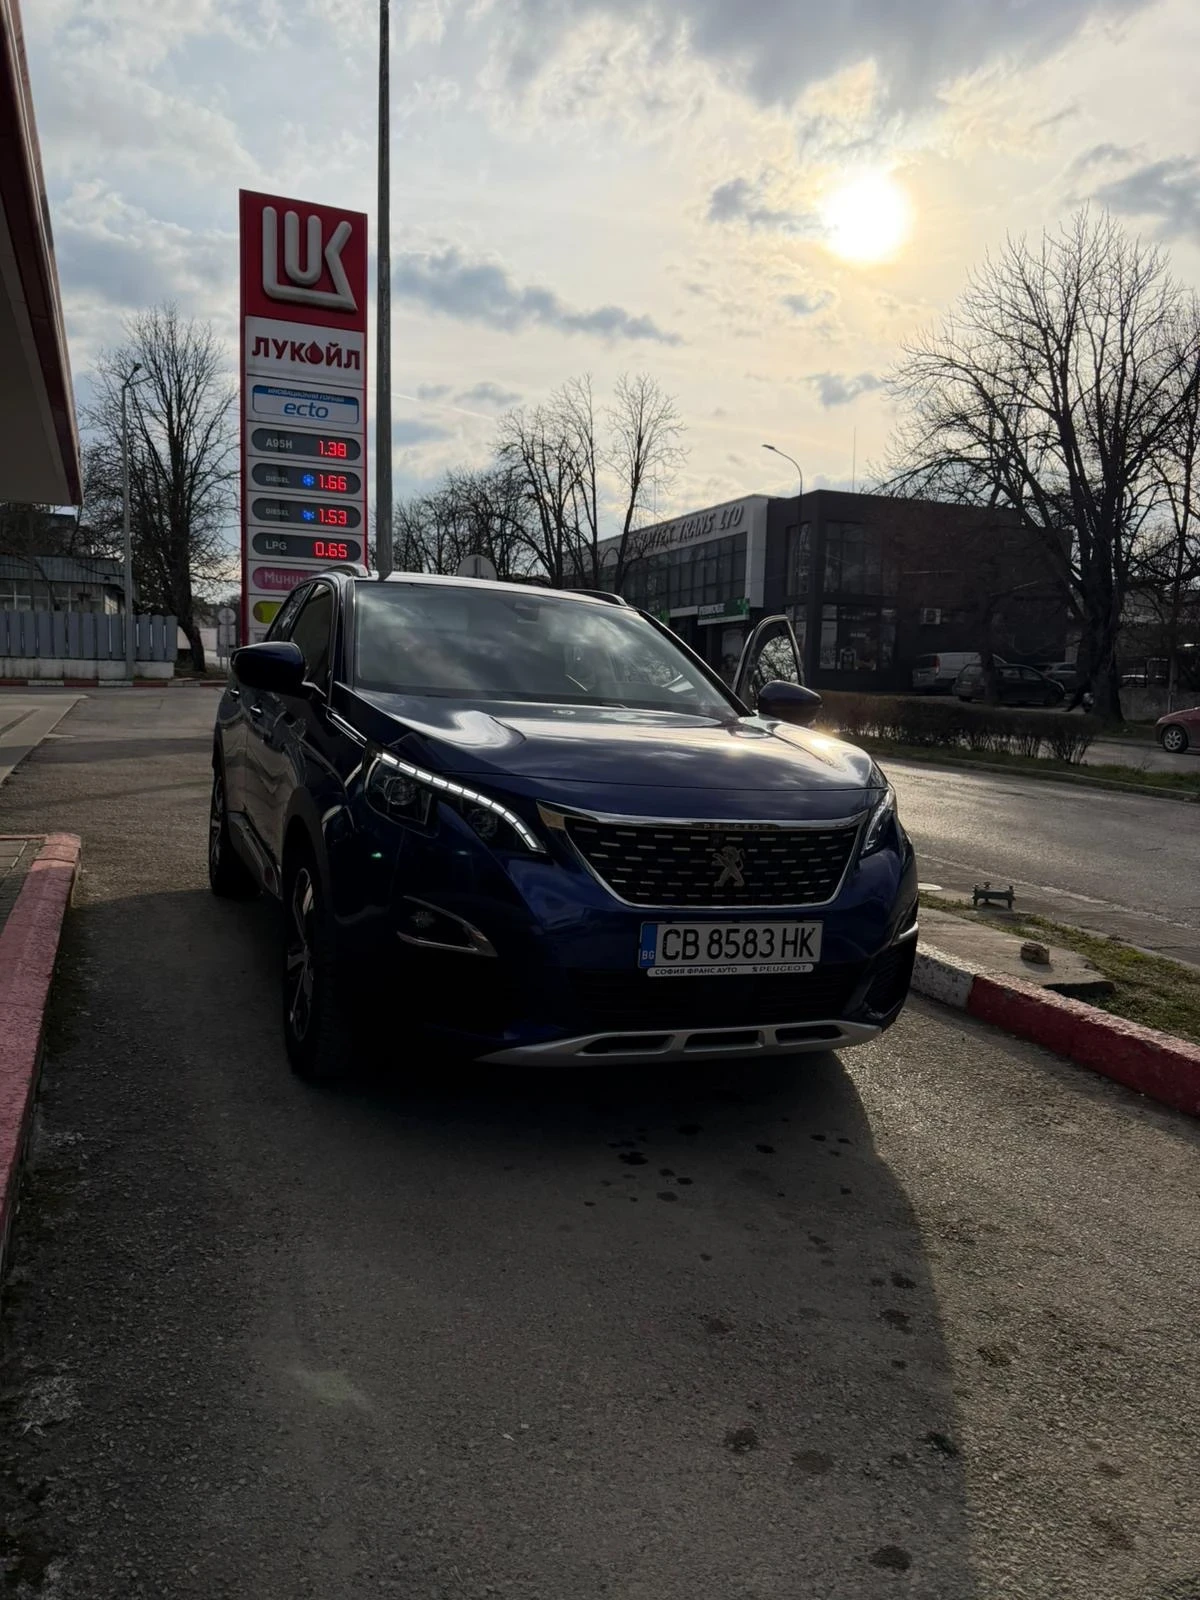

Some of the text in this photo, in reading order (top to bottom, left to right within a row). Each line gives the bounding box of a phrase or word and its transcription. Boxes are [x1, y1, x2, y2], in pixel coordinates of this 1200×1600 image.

[252, 336, 360, 370] ЛУКОЙЛ
[284, 402, 329, 419] ecto
[319, 440, 347, 457] 1.38
[319, 474, 347, 492] 1.66
[319, 508, 347, 525] 1.53
[678, 513, 716, 542] TRANS
[265, 540, 348, 558] LPG 0.65
[661, 926, 817, 961] CB 8583 HK
[641, 950, 655, 960] BG
[654, 964, 808, 975] СОФИЯ ФРАНС АУТО PEUGEOT
